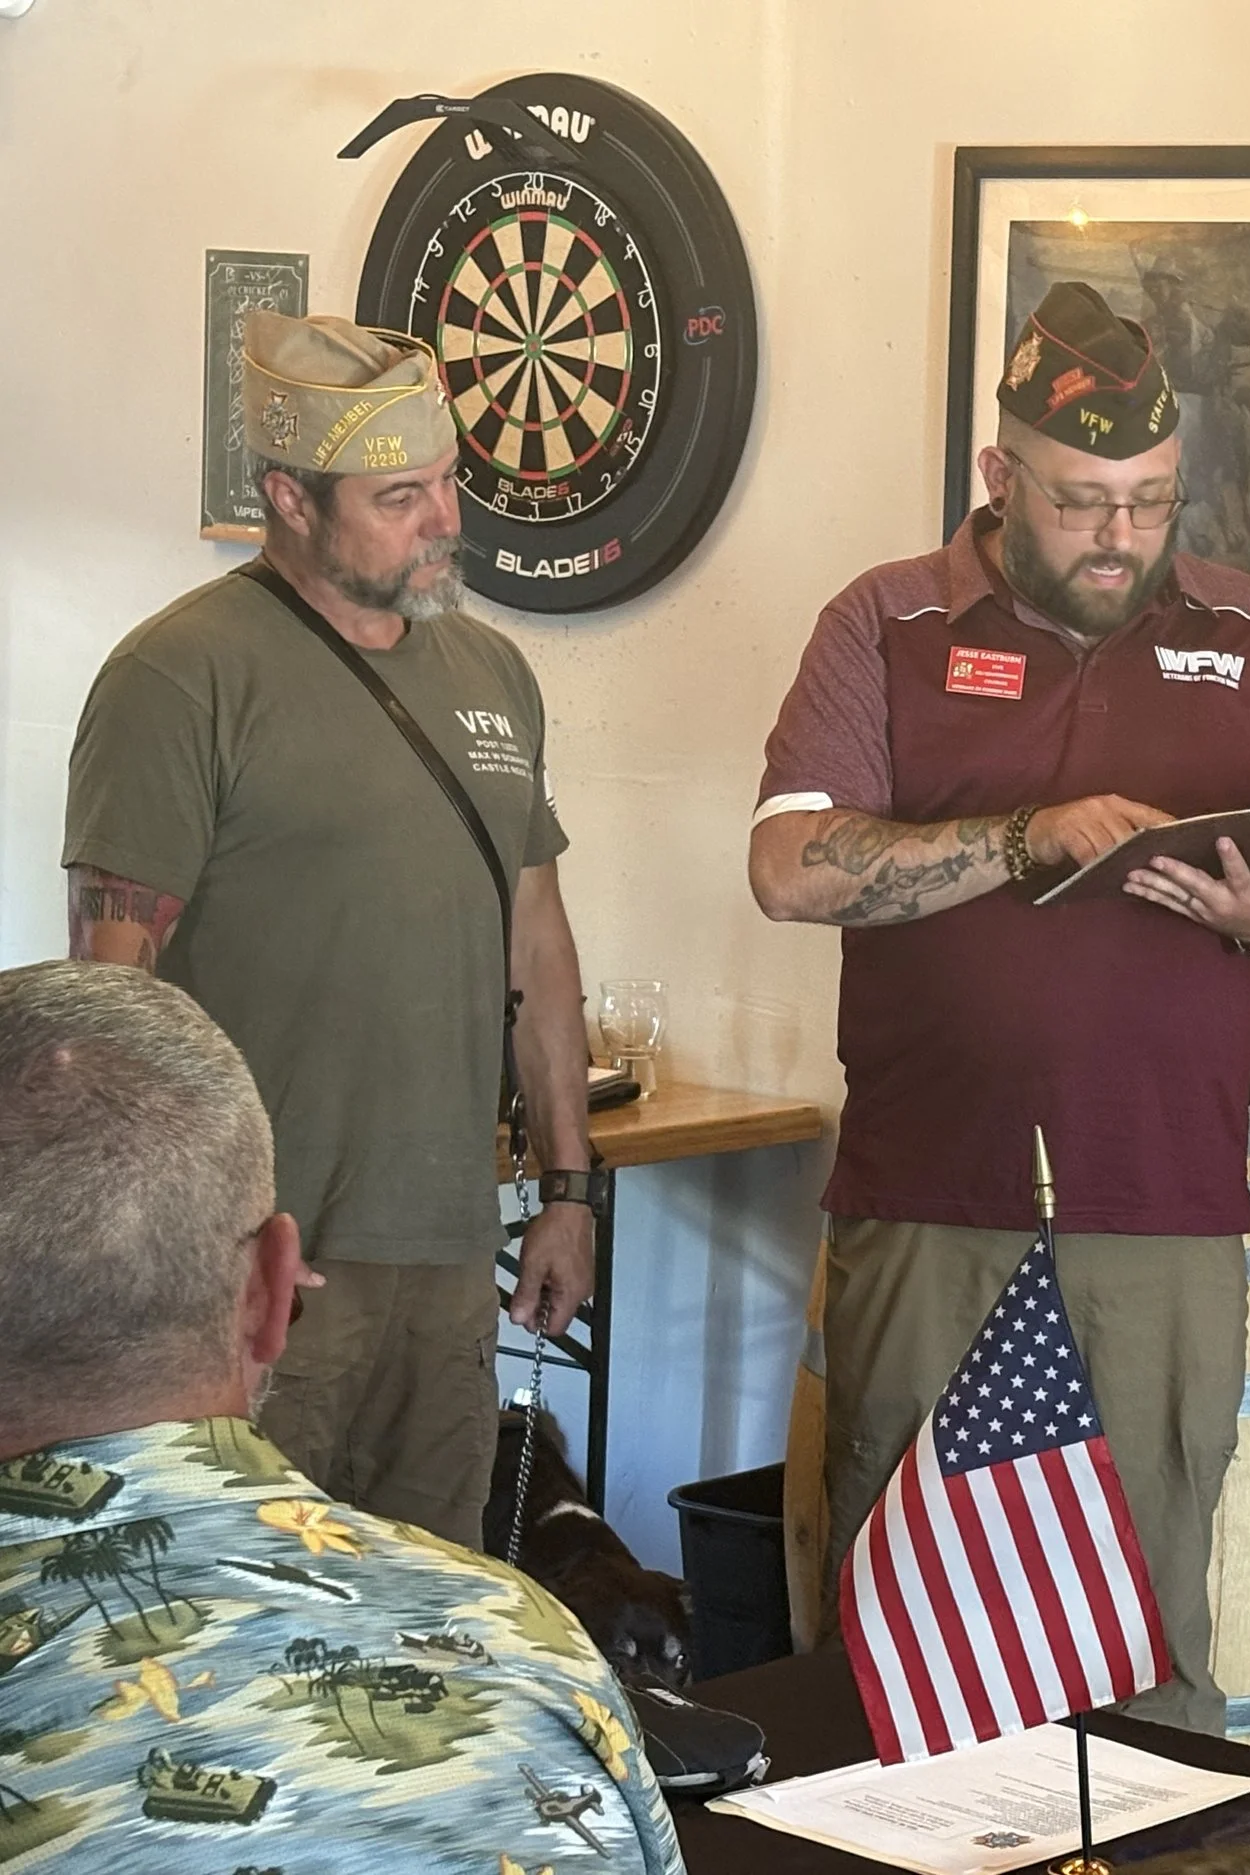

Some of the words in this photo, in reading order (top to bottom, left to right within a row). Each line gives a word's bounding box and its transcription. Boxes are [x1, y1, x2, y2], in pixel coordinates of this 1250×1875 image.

[490, 179, 503, 198] 5
[524, 172, 544, 191] 20
[454, 198, 477, 223] 12
[500, 189, 568, 211] WINMAU
[594, 201, 613, 227] 18
[411, 277, 430, 303] 14
[688, 315, 723, 338] PDC
[1080, 408, 1114, 434] VFW
[1148, 389, 1168, 434] STATE
[312, 440, 333, 467] LIFE
[328, 400, 374, 442] MEMBER
[364, 435, 403, 453] VFW
[1089, 431, 1097, 445] 1
[361, 451, 408, 471] 12230
[600, 472, 616, 492] 2
[488, 492, 509, 514] 19
[528, 501, 540, 523] 3
[566, 492, 583, 517] 17
[1154, 645, 1246, 681] VFW
[454, 710, 513, 738] VFW
[473, 763, 511, 774] CASTLE
